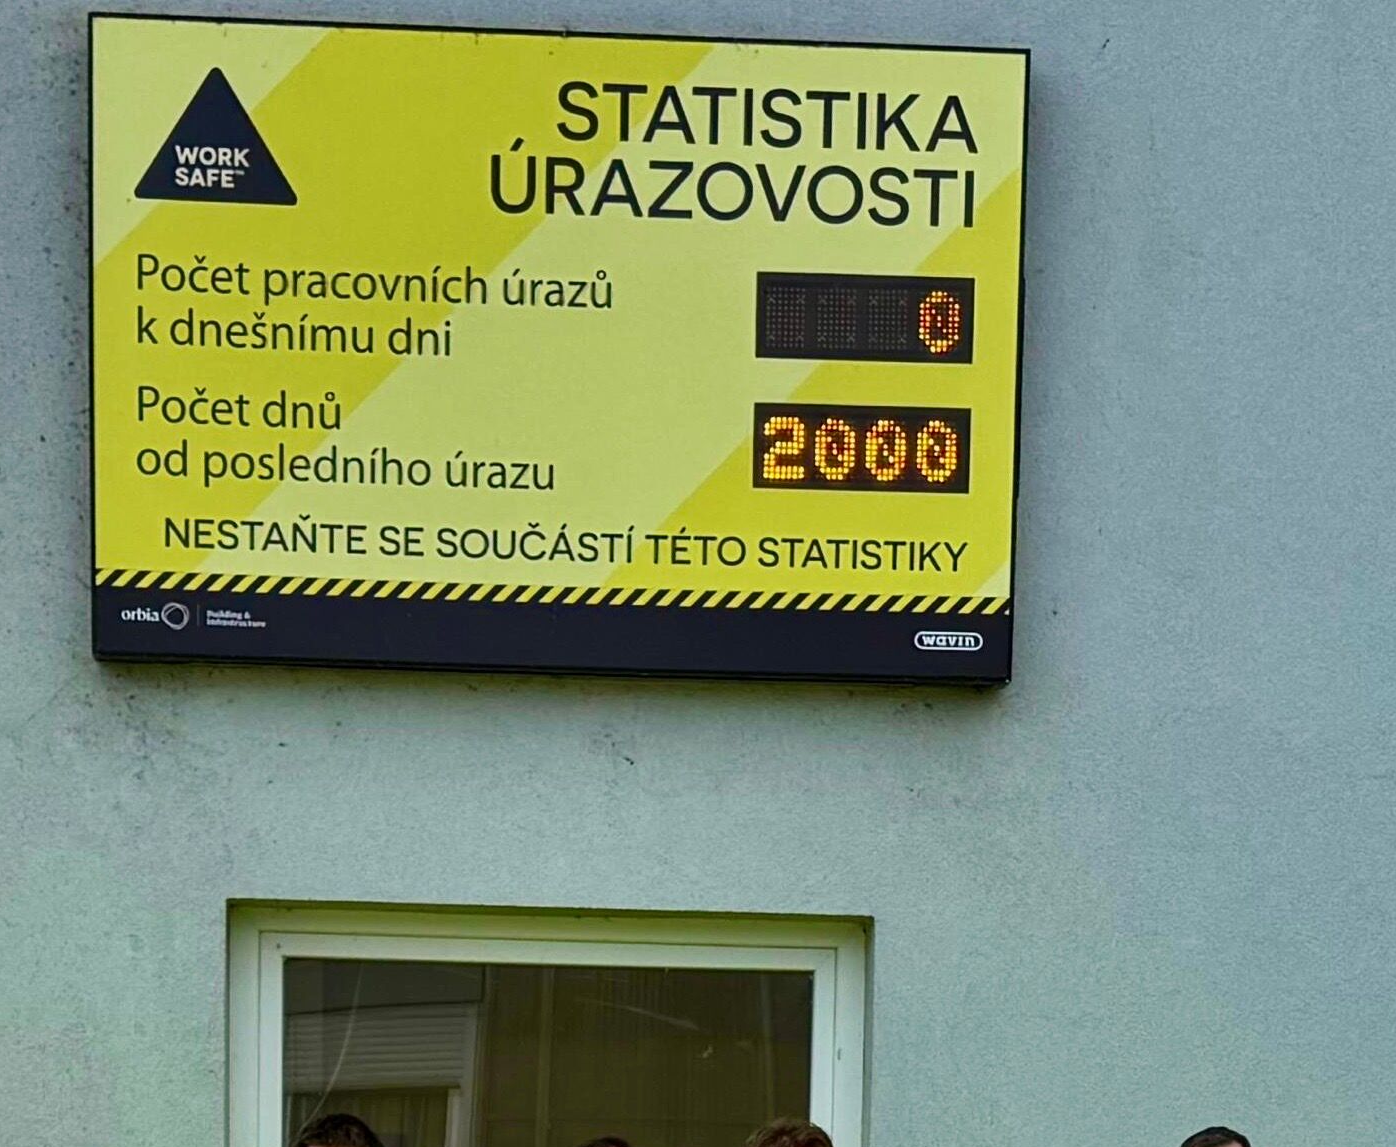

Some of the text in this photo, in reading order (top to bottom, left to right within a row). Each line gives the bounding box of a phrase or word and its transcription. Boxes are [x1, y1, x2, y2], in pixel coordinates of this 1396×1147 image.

[557, 81, 978, 154] STATISTIKA
[174, 145, 250, 167] WORK
[491, 137, 974, 228] ÚRAZOVOSTI
[137, 253, 612, 309] Počet pracovních úrazů
[137, 305, 451, 356] k dnešnímu dni
[919, 290, 959, 353] 0
[138, 386, 340, 430] Počet dnů
[137, 439, 554, 490] od posledního úrazu
[763, 416, 958, 483] 2000
[165, 514, 968, 572] NESTAŇTE SE SOUČÁSTÍ TÉTO STATISTIKY
[121, 607, 160, 622] orbia
[920, 634, 975, 648] wavin
